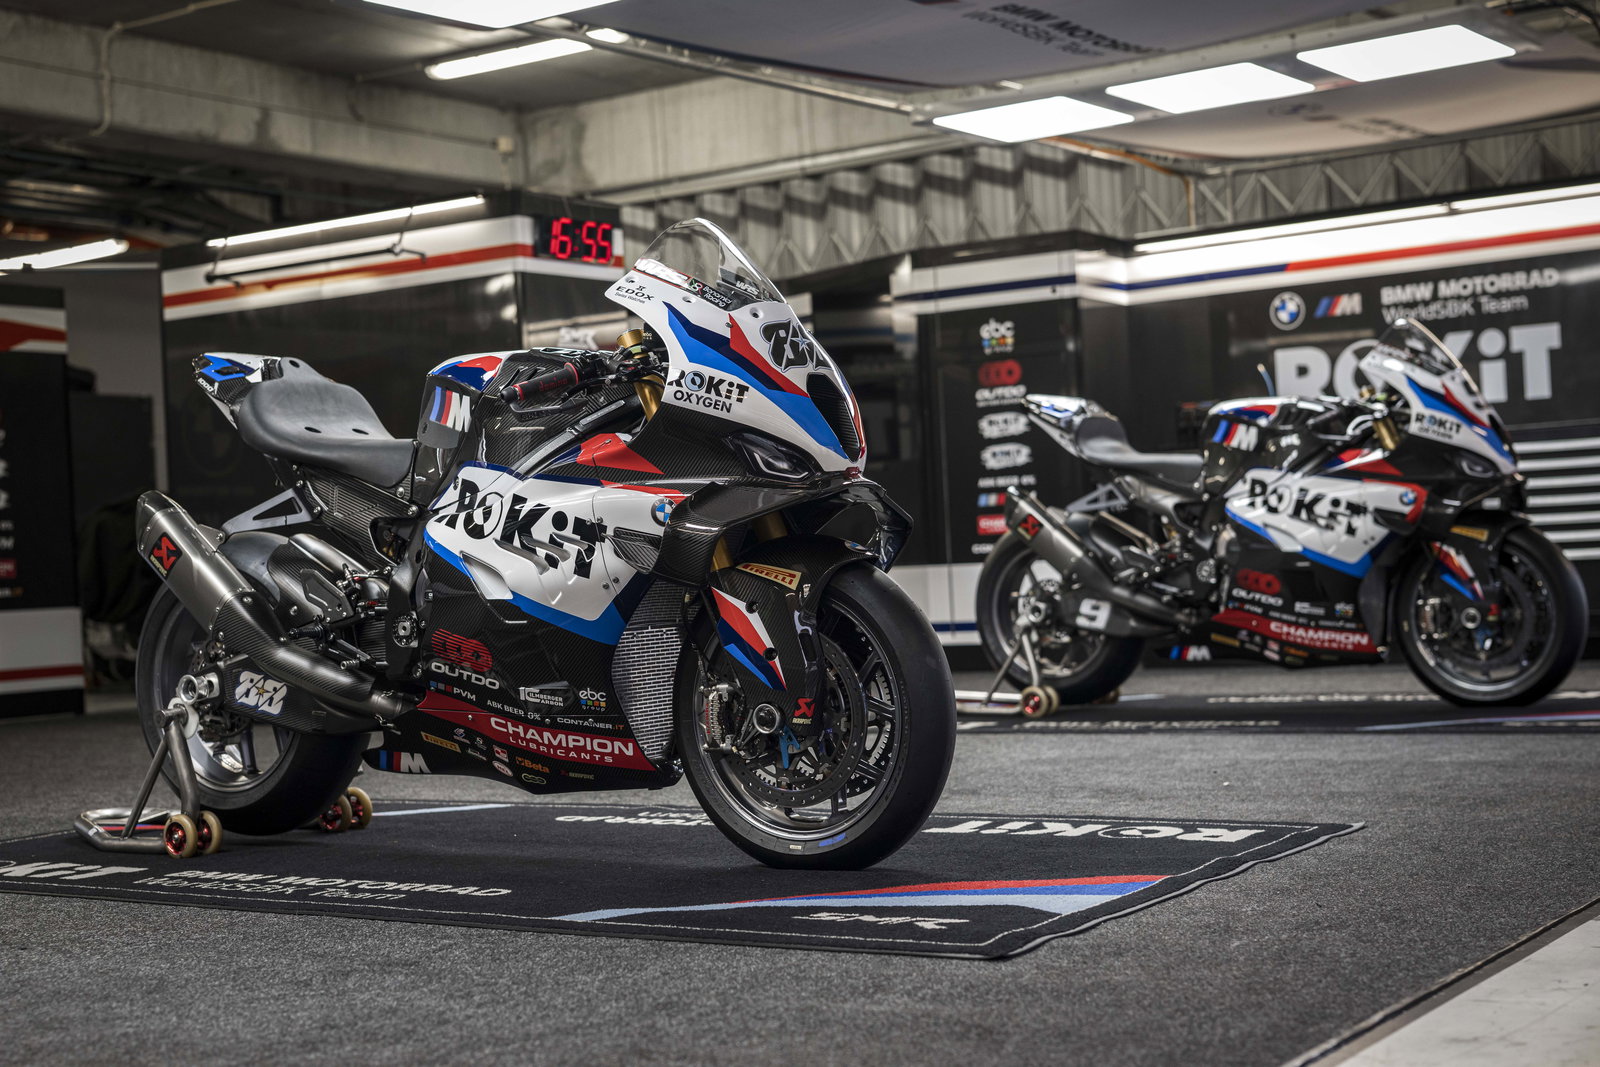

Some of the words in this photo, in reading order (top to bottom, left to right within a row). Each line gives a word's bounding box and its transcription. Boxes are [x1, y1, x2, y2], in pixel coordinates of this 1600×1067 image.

[550, 216, 612, 264] 16:55
[615, 285, 656, 301] EDOX
[1380, 284, 1434, 306] BMW
[1438, 267, 1560, 299] MOTORRAD
[1480, 295, 1530, 314] Team
[673, 388, 733, 414] OXYGEN
[741, 563, 797, 586] PIRELLI
[1075, 598, 1113, 630] 9
[1269, 621, 1370, 646] CHAMPION
[431, 661, 500, 690] OUTDO
[453, 687, 476, 702] PVM
[578, 687, 607, 702] ebc
[486, 699, 503, 710] ABK
[503, 704, 525, 718] BEER
[489, 716, 635, 757] CHAMPION
[509, 736, 614, 764] LUBRICANTS
[267, 876, 513, 897] MOTORRAD
